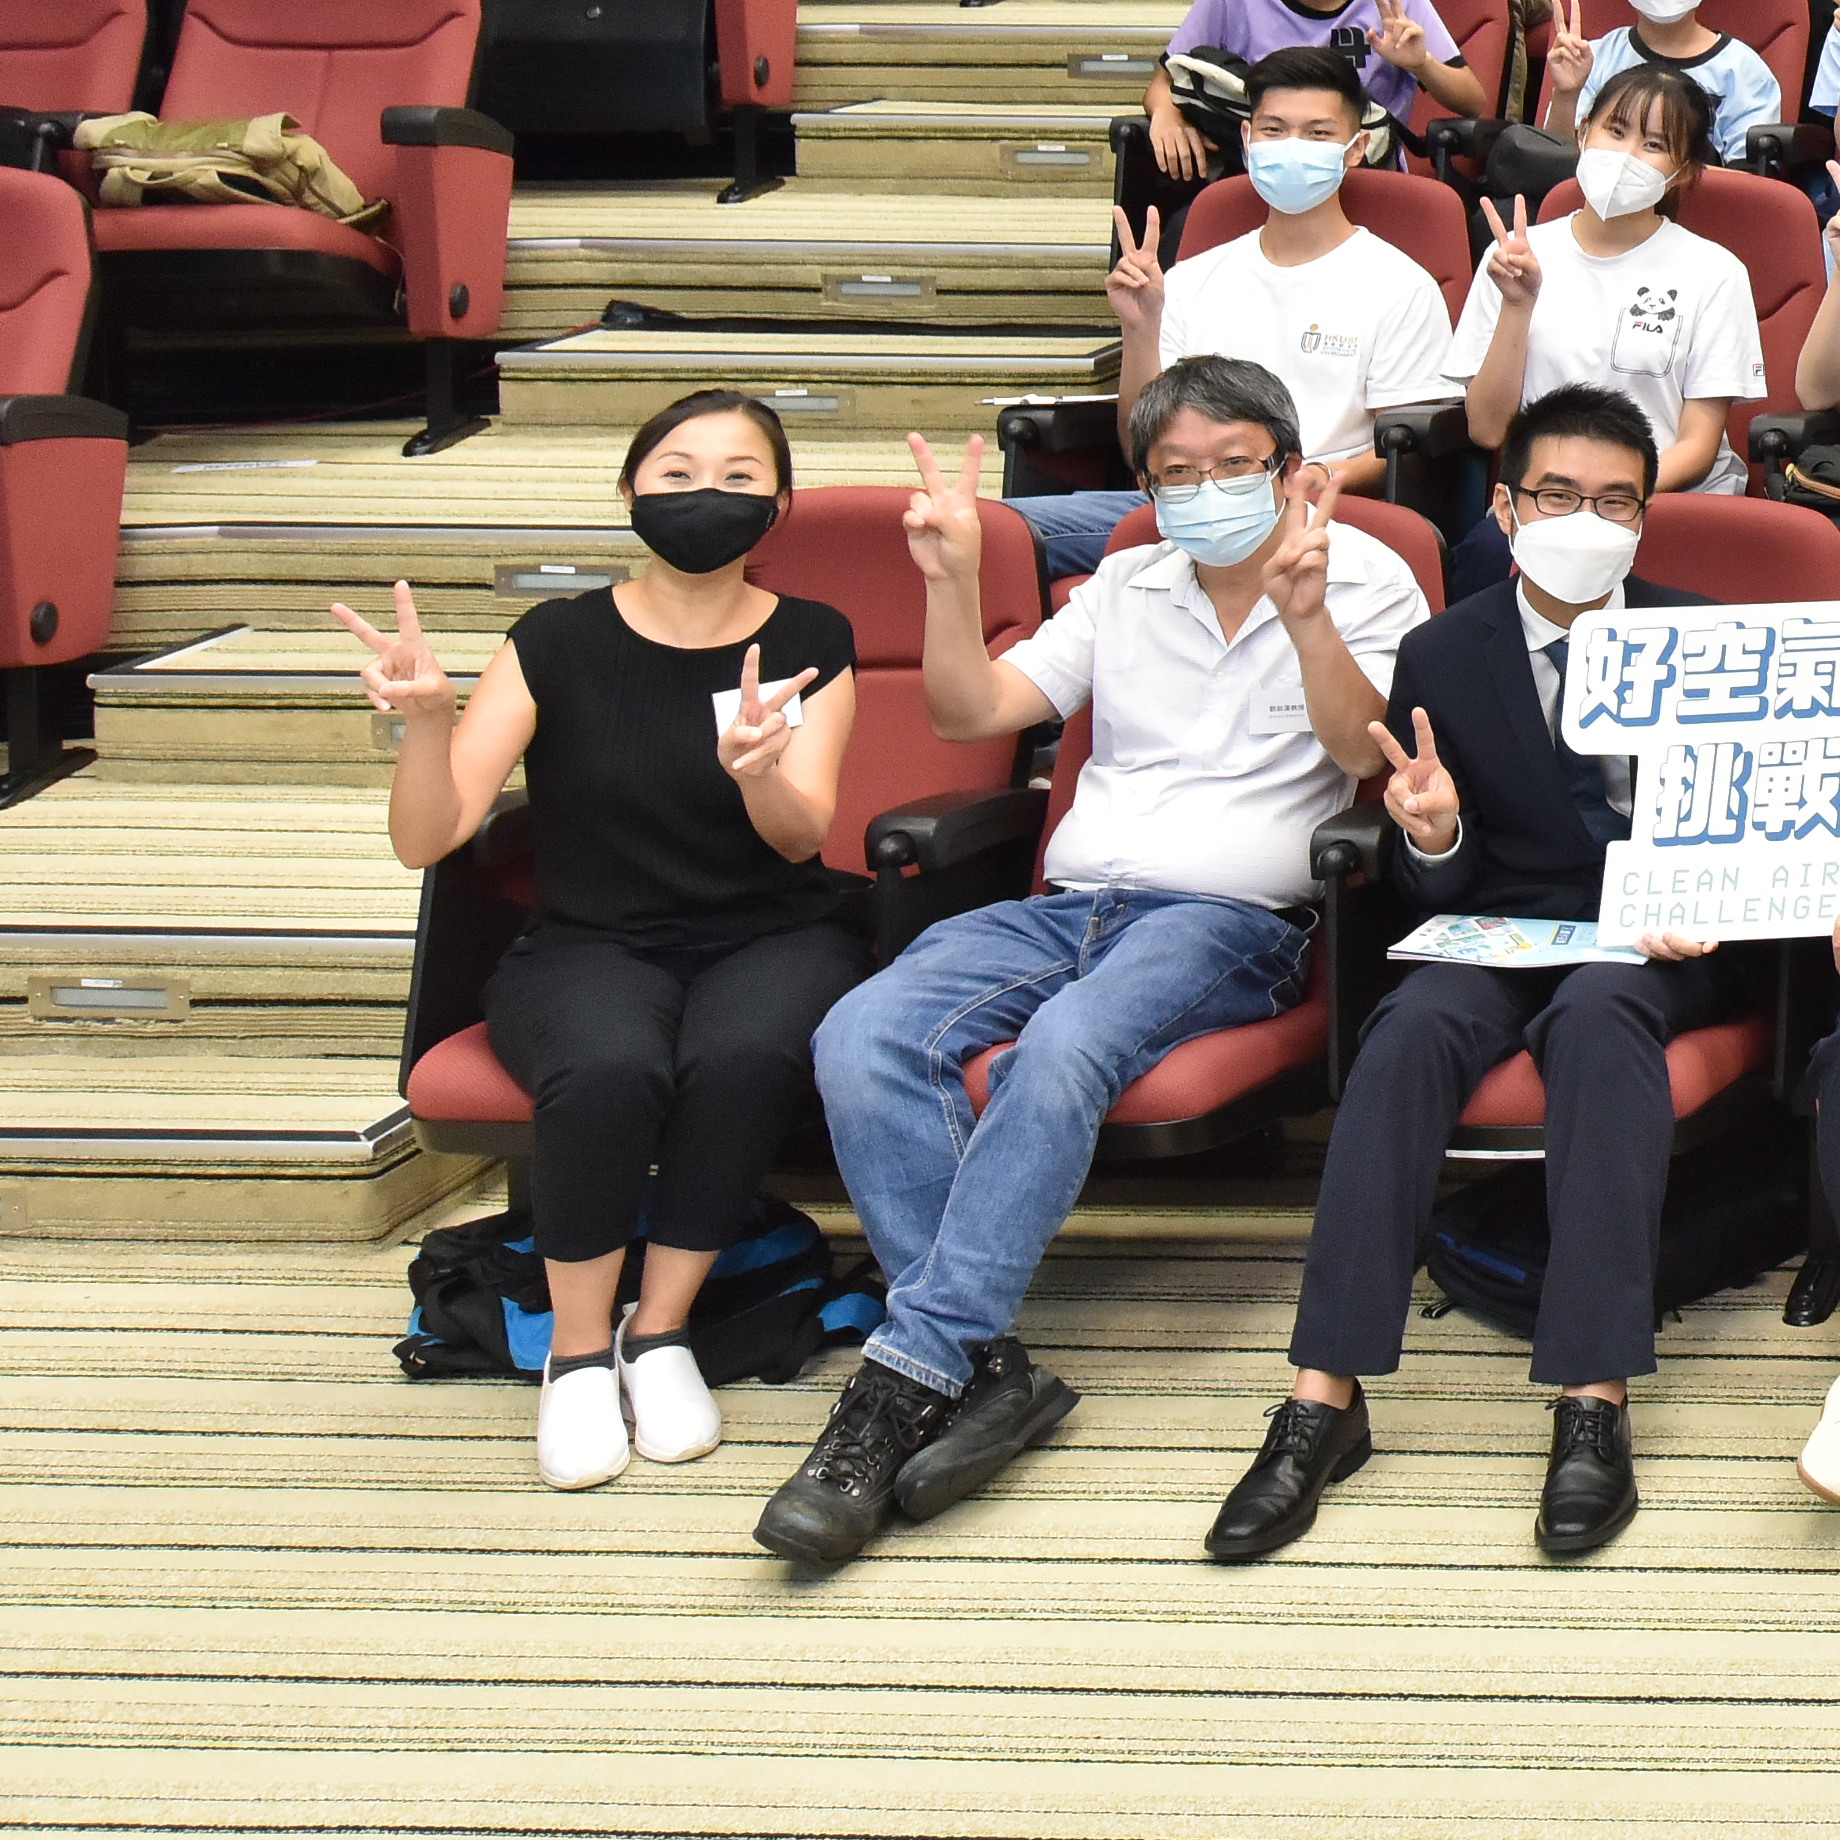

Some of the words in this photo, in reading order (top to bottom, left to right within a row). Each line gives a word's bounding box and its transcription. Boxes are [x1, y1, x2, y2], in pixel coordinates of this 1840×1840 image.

[1632, 321, 1663, 334] FILA
[1623, 867, 1739, 896] CLEAN
[1772, 862, 1840, 888] AIR
[1619, 894, 1836, 928] CHALLENGE
